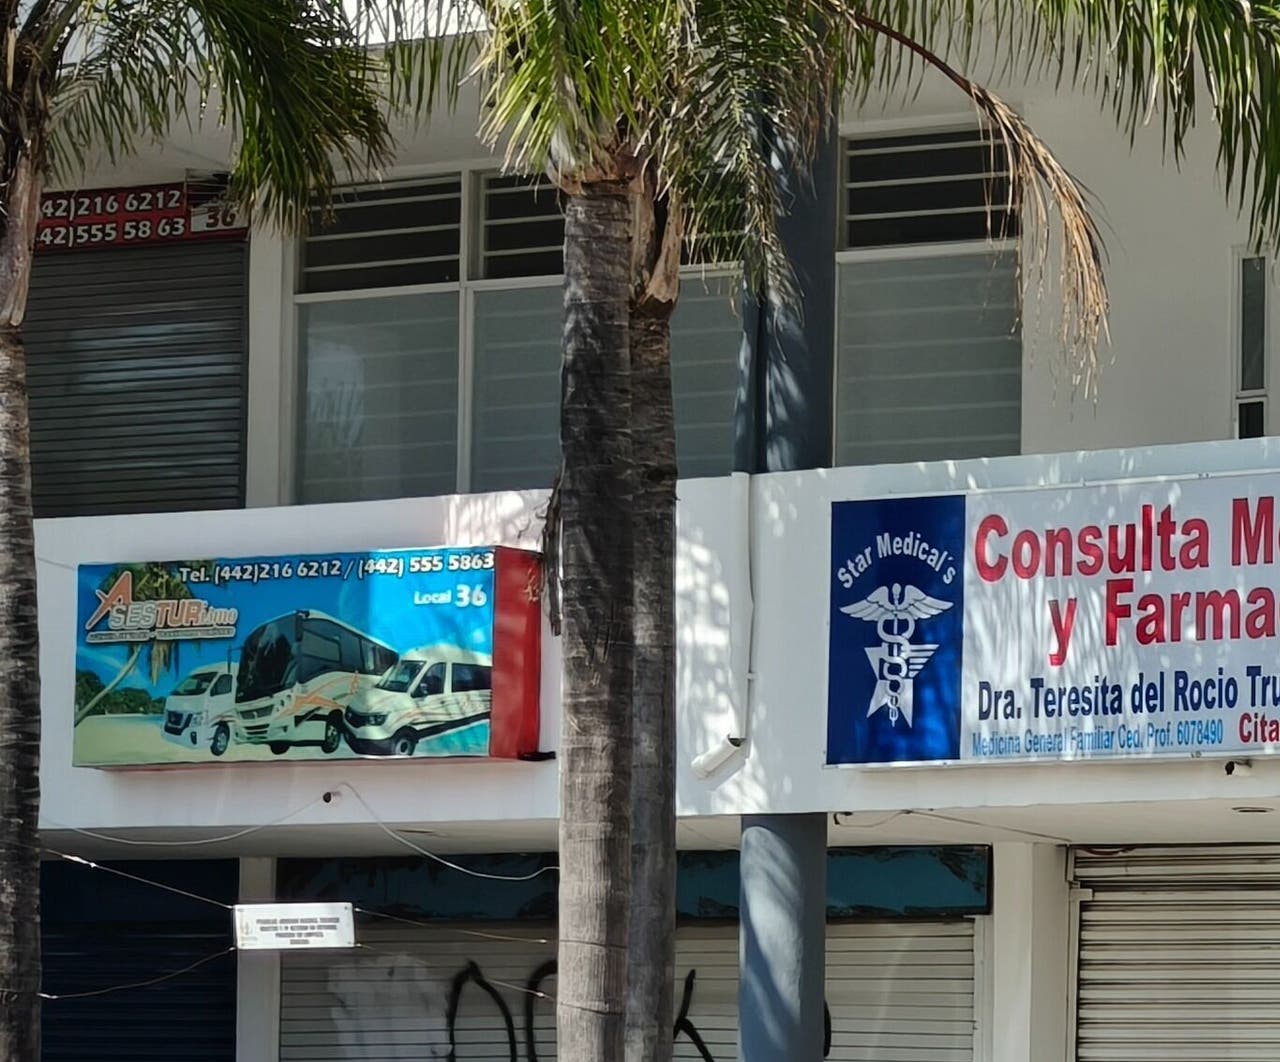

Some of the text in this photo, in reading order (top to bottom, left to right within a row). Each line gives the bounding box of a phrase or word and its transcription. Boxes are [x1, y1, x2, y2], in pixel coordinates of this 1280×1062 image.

[40, 190, 181, 221] 42)216 6212
[39, 218, 186, 247] 42)555 58 63
[974, 503, 1210, 583] Consulta
[180, 567, 210, 583] Tel.
[297, 560, 341, 577] 6212
[358, 557, 404, 579] (442)
[409, 556, 443, 573] 555
[448, 552, 495, 571] 5863
[837, 546, 872, 589] Star
[413, 584, 487, 608] Local 36
[1048, 597, 1078, 667] y
[978, 681, 1022, 721] Dra.
[1030, 676, 1123, 718] Teresita
[1131, 671, 1165, 713] del
[1173, 667, 1239, 712] Rocio
[972, 719, 1223, 757] Medicina General Familiar Ced. Prof. 6078490
